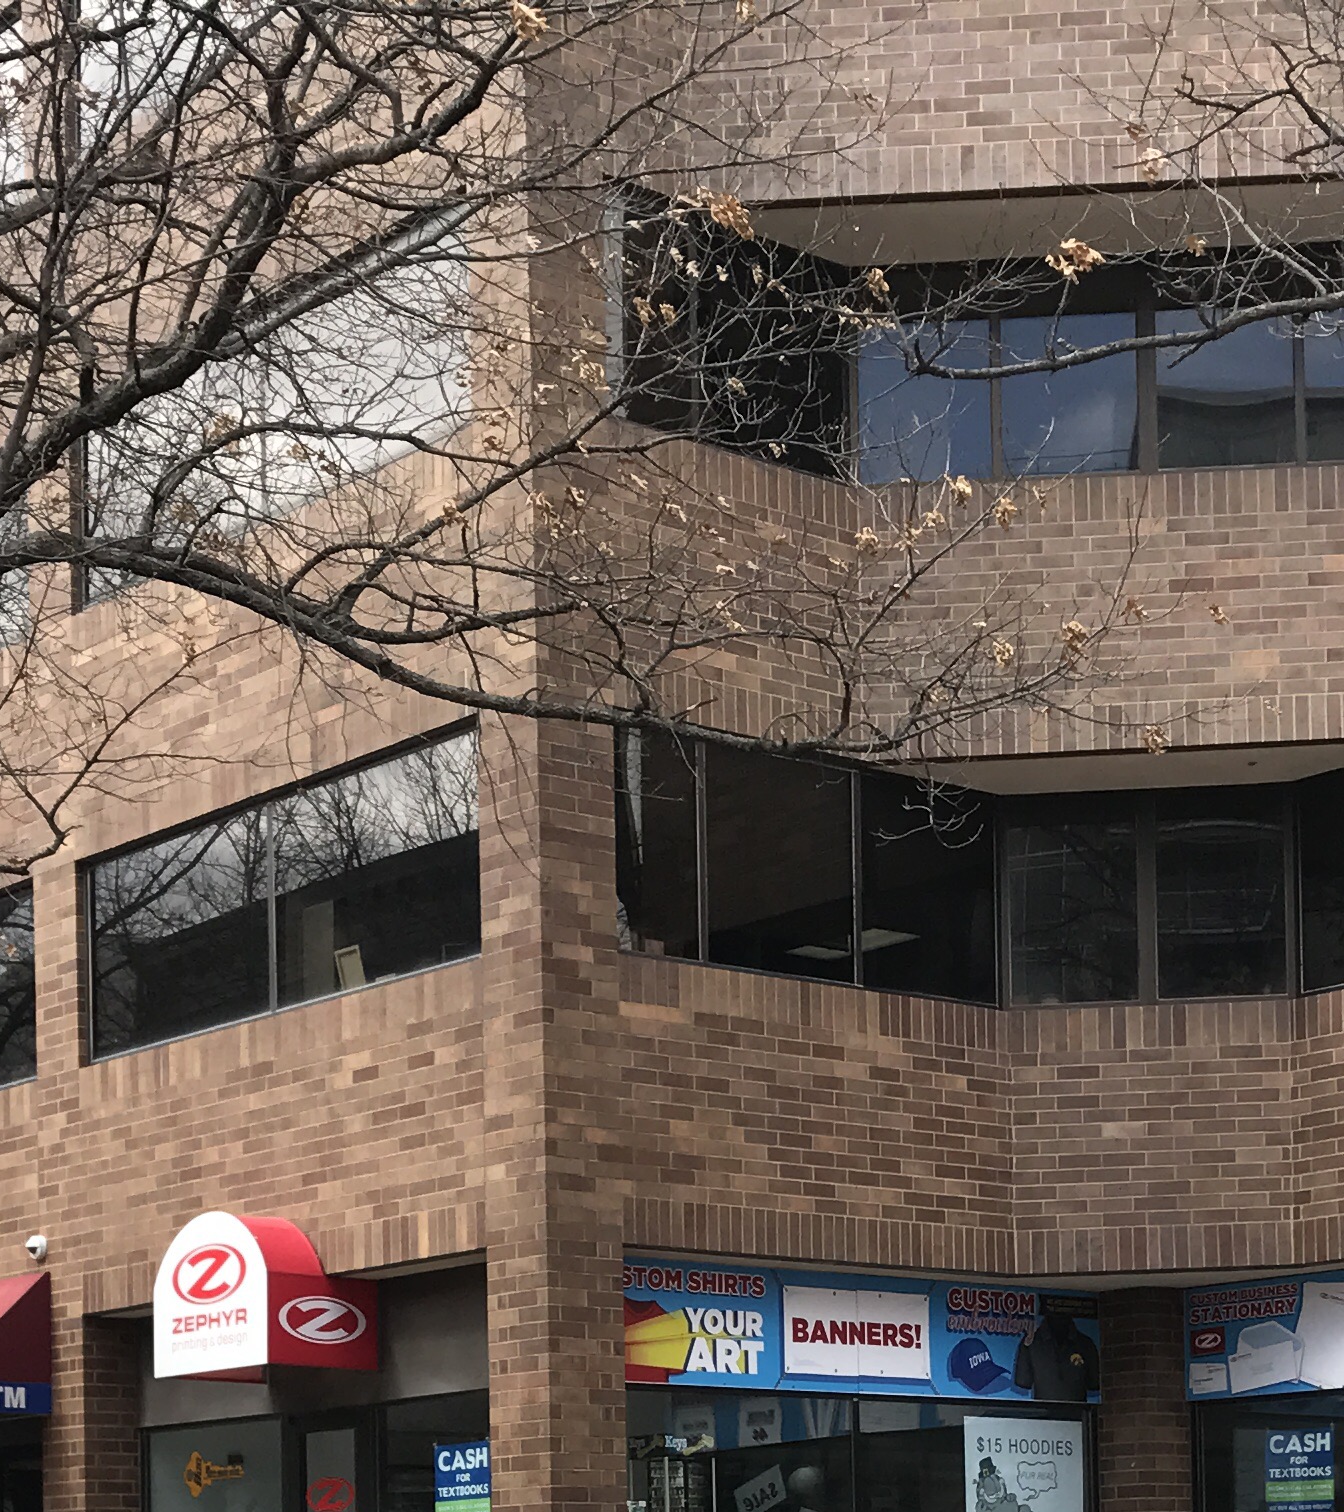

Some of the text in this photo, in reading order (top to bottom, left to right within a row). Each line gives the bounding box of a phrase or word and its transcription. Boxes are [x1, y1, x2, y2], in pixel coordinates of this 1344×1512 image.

[686, 1270, 766, 1298] SHIRTS
[1190, 1288, 1237, 1306] CUSTOM
[1240, 1282, 1299, 1300] BUSINESS
[947, 1286, 1037, 1316] CUSTOM
[1189, 1299, 1298, 1325] STATIONARY
[172, 1308, 248, 1335] ZEPHYR
[684, 1307, 764, 1338] YOUR
[792, 1317, 922, 1349] BANNERS!
[171, 1335, 207, 1355] printing
[217, 1332, 248, 1350] design
[686, 1337, 765, 1375] ART
[969, 1351, 991, 1369] IOWA
[664, 1435, 688, 1452] Keys
[977, 1436, 1074, 1457] $15 HOODIES
[1269, 1432, 1331, 1454] CASH
[437, 1447, 488, 1472] CASH
[1289, 1456, 1309, 1465] FOR
[456, 1472, 471, 1483] FOR
[1268, 1465, 1332, 1479] TEXTBOOKS
[437, 1483, 489, 1498] TEXTBOOKS
